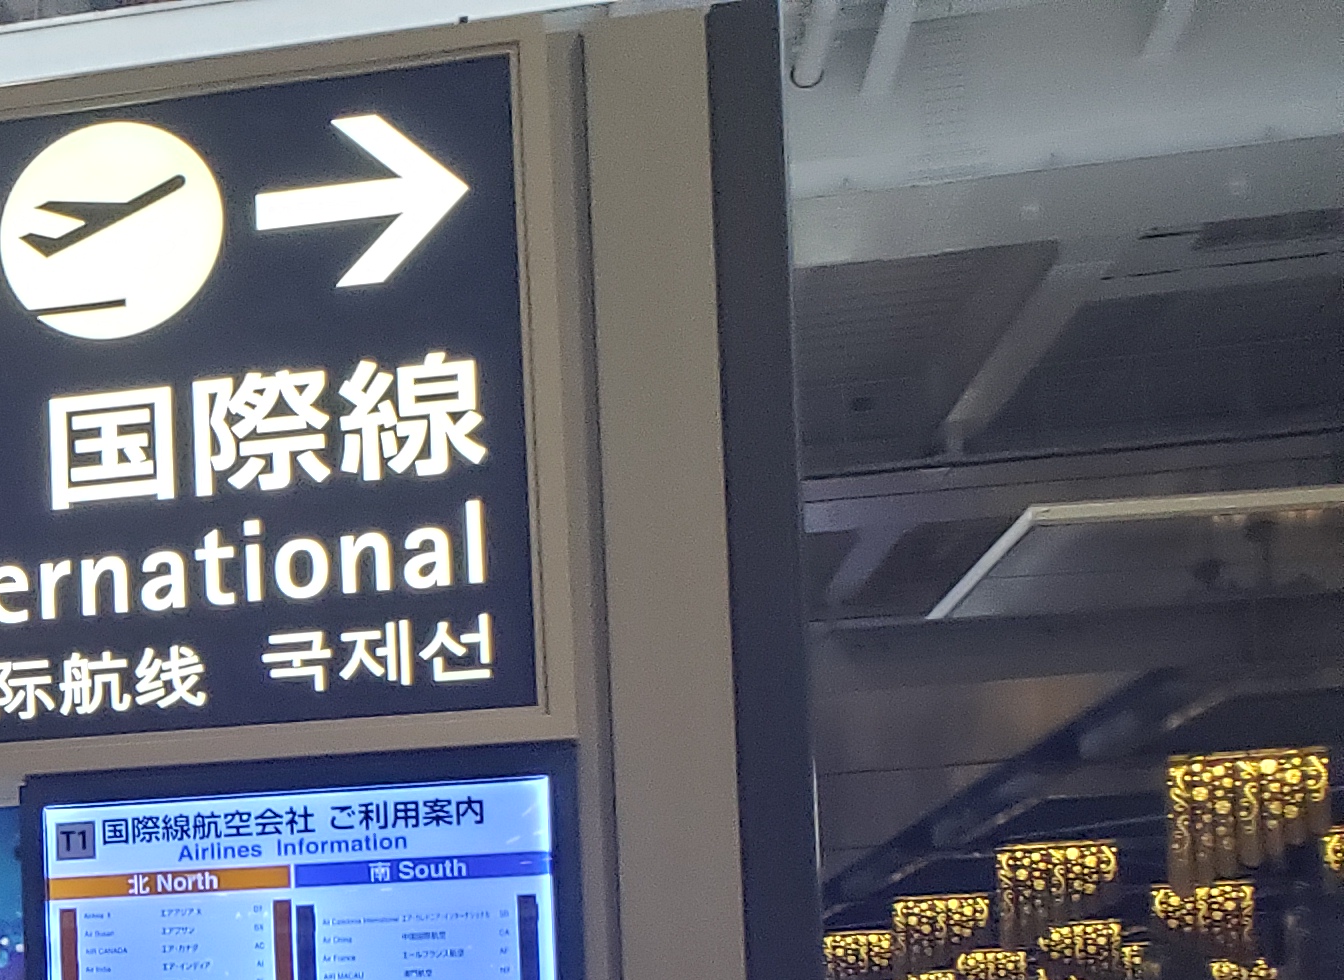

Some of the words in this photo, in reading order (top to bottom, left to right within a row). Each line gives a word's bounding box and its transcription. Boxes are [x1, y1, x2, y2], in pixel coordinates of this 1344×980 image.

[47, 350, 488, 512] 国際線
[260, 612, 494, 694] 국제선
[102, 804, 316, 847] 国際線航空会社
[328, 796, 486, 832] ご利用案内
[60, 828, 89, 853] T1
[177, 840, 263, 863] Airlines
[277, 833, 408, 857] Information
[128, 875, 150, 896] 北
[155, 871, 219, 893] North
[368, 862, 390, 883] 南
[398, 859, 467, 881] South
